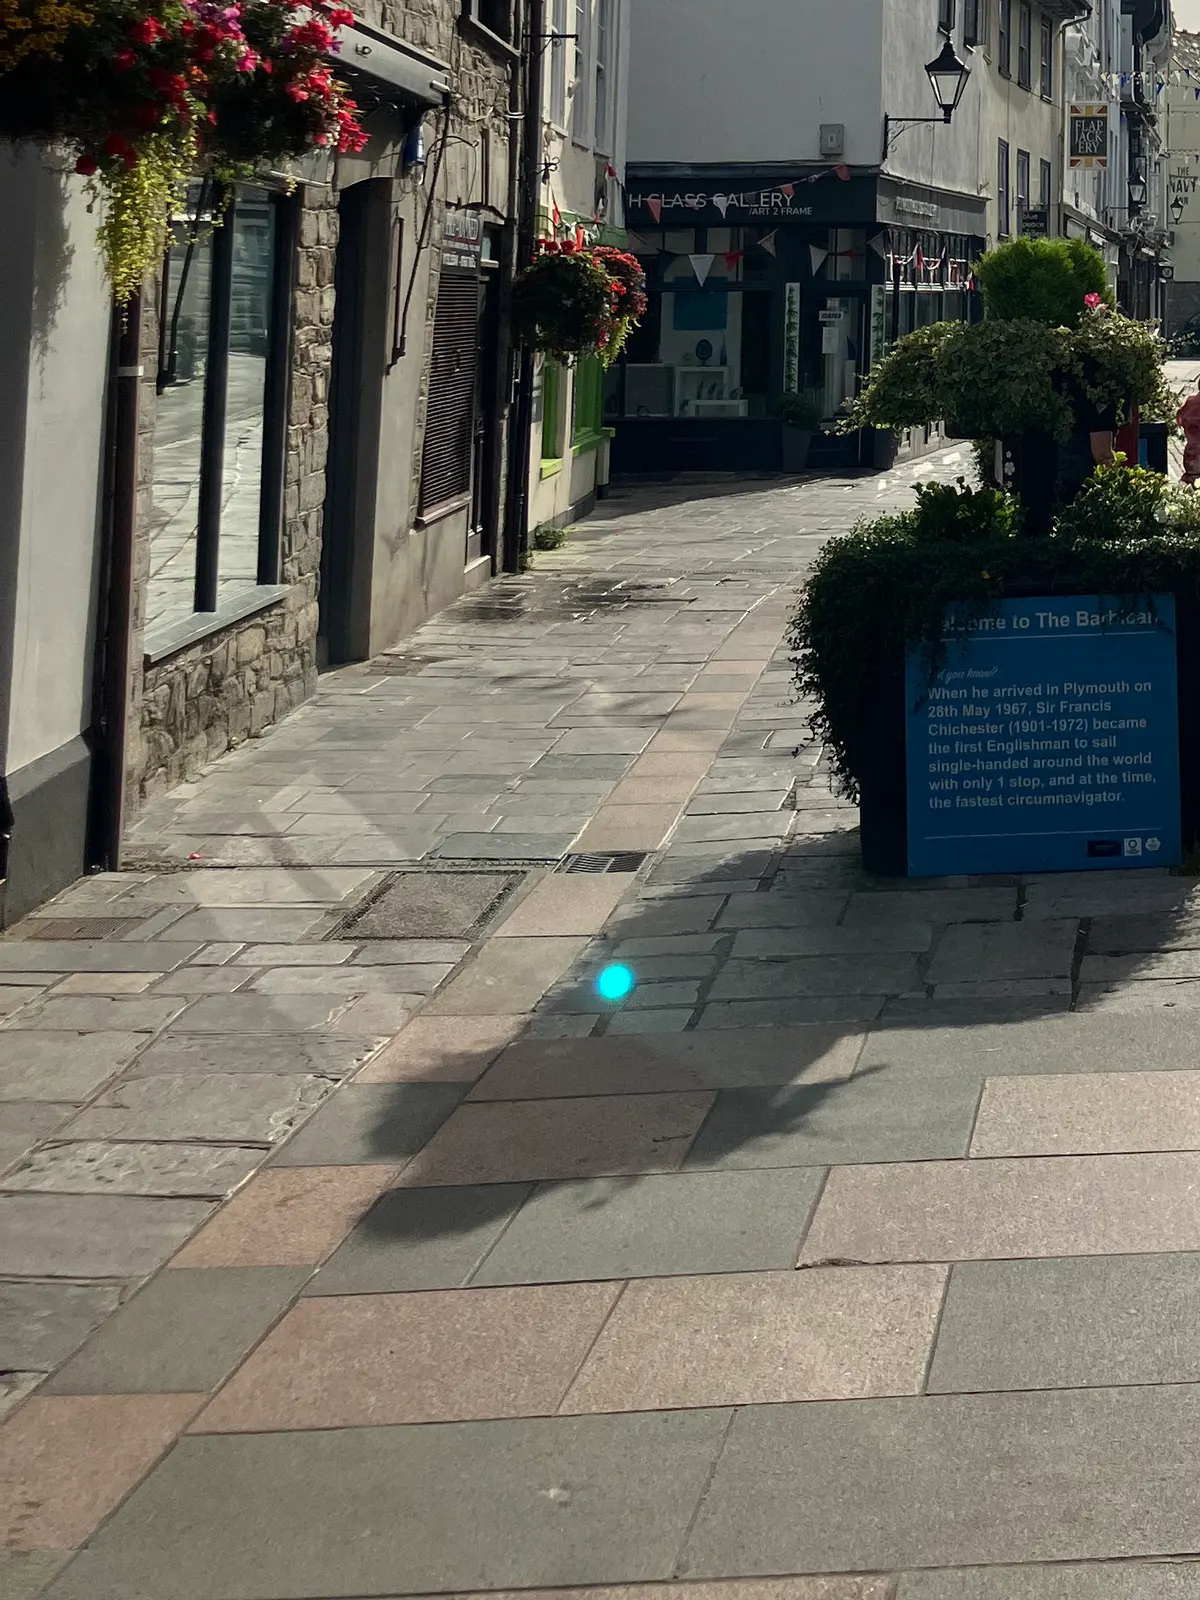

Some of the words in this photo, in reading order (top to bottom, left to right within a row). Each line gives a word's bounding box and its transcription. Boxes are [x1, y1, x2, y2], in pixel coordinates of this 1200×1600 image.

[1075, 120, 1103, 132] FLAP
[1075, 131, 1103, 144] JACK
[1078, 142, 1101, 153] ERY
[1177, 167, 1190, 176] THE
[1169, 179, 1196, 193] NAVY
[773, 207, 779, 215] 2
[781, 207, 813, 216] FRAME
[1013, 614, 1030, 629] to
[1035, 611, 1070, 629] The
[945, 670, 965, 684] you
[967, 666, 998, 679] know?
[928, 687, 967, 699] When
[972, 685, 988, 698] he
[993, 683, 1042, 698] arrived
[1046, 683, 1059, 696] in
[1063, 680, 1130, 697] Plymouth
[1134, 681, 1152, 692] on
[928, 705, 958, 718] 28th
[962, 704, 991, 719] May
[996, 702, 1032, 716] 1967,
[1036, 700, 1056, 714] Sir
[1060, 699, 1112, 713] Francis
[928, 722, 1004, 736] Chichester
[1009, 718, 1088, 736] (1901-1972)
[1093, 717, 1147, 730] became
[928, 741, 950, 754] the
[955, 740, 982, 754] first
[987, 738, 1070, 754] Englishman
[1074, 737, 1088, 748] to
[1092, 735, 1117, 748] sail
[928, 757, 1029, 774] single-handed
[1033, 754, 1082, 769] around
[1087, 753, 1109, 766] the
[1113, 751, 1152, 765] world
[928, 778, 958, 791] with
[962, 776, 993, 791] only
[997, 775, 1004, 787] 1
[1009, 775, 1045, 790] stop,
[1049, 773, 1075, 786] and
[1080, 773, 1093, 785] at
[1096, 771, 1118, 785] the
[1122, 770, 1157, 784] time,
[929, 796, 951, 809] the
[955, 794, 1004, 808] fastest
[1007, 790, 1126, 806] circumnavigator.
